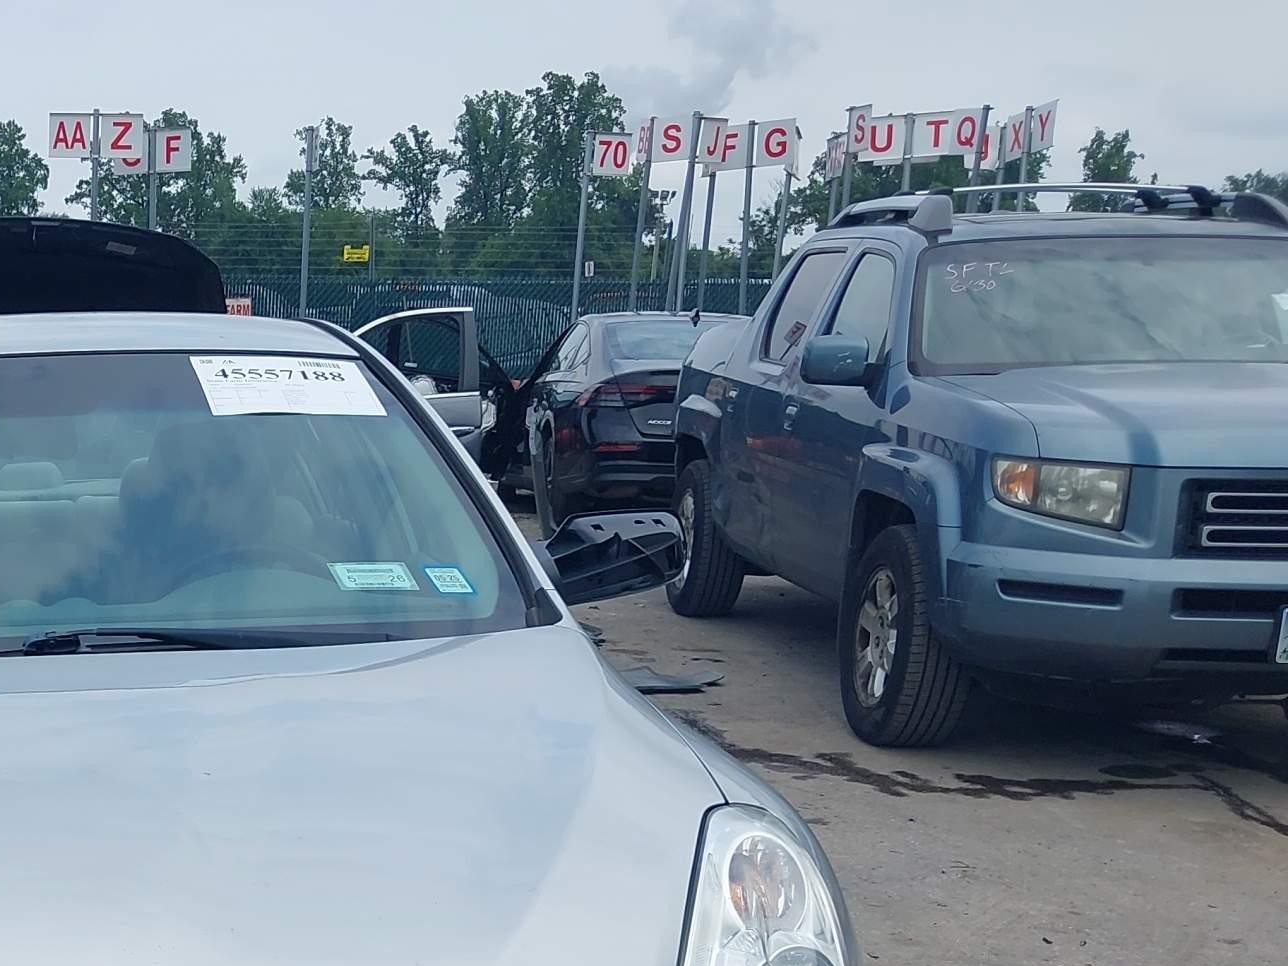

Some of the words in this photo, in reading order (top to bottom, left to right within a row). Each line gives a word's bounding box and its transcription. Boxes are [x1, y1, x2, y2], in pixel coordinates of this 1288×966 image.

[53, 121, 87, 149] AA
[111, 122, 133, 150] Z
[661, 124, 682, 153] S
[706, 126, 720, 156] J
[854, 113, 866, 144] S
[870, 123, 893, 153] U
[926, 119, 949, 148] T
[956, 115, 976, 148] Q
[1011, 120, 1024, 152] X
[1038, 110, 1052, 142] Y
[165, 135, 182, 164] F
[598, 140, 628, 168] 70
[721, 132, 739, 162] F
[764, 127, 788, 158] G
[214, 367, 346, 383] 45557188
